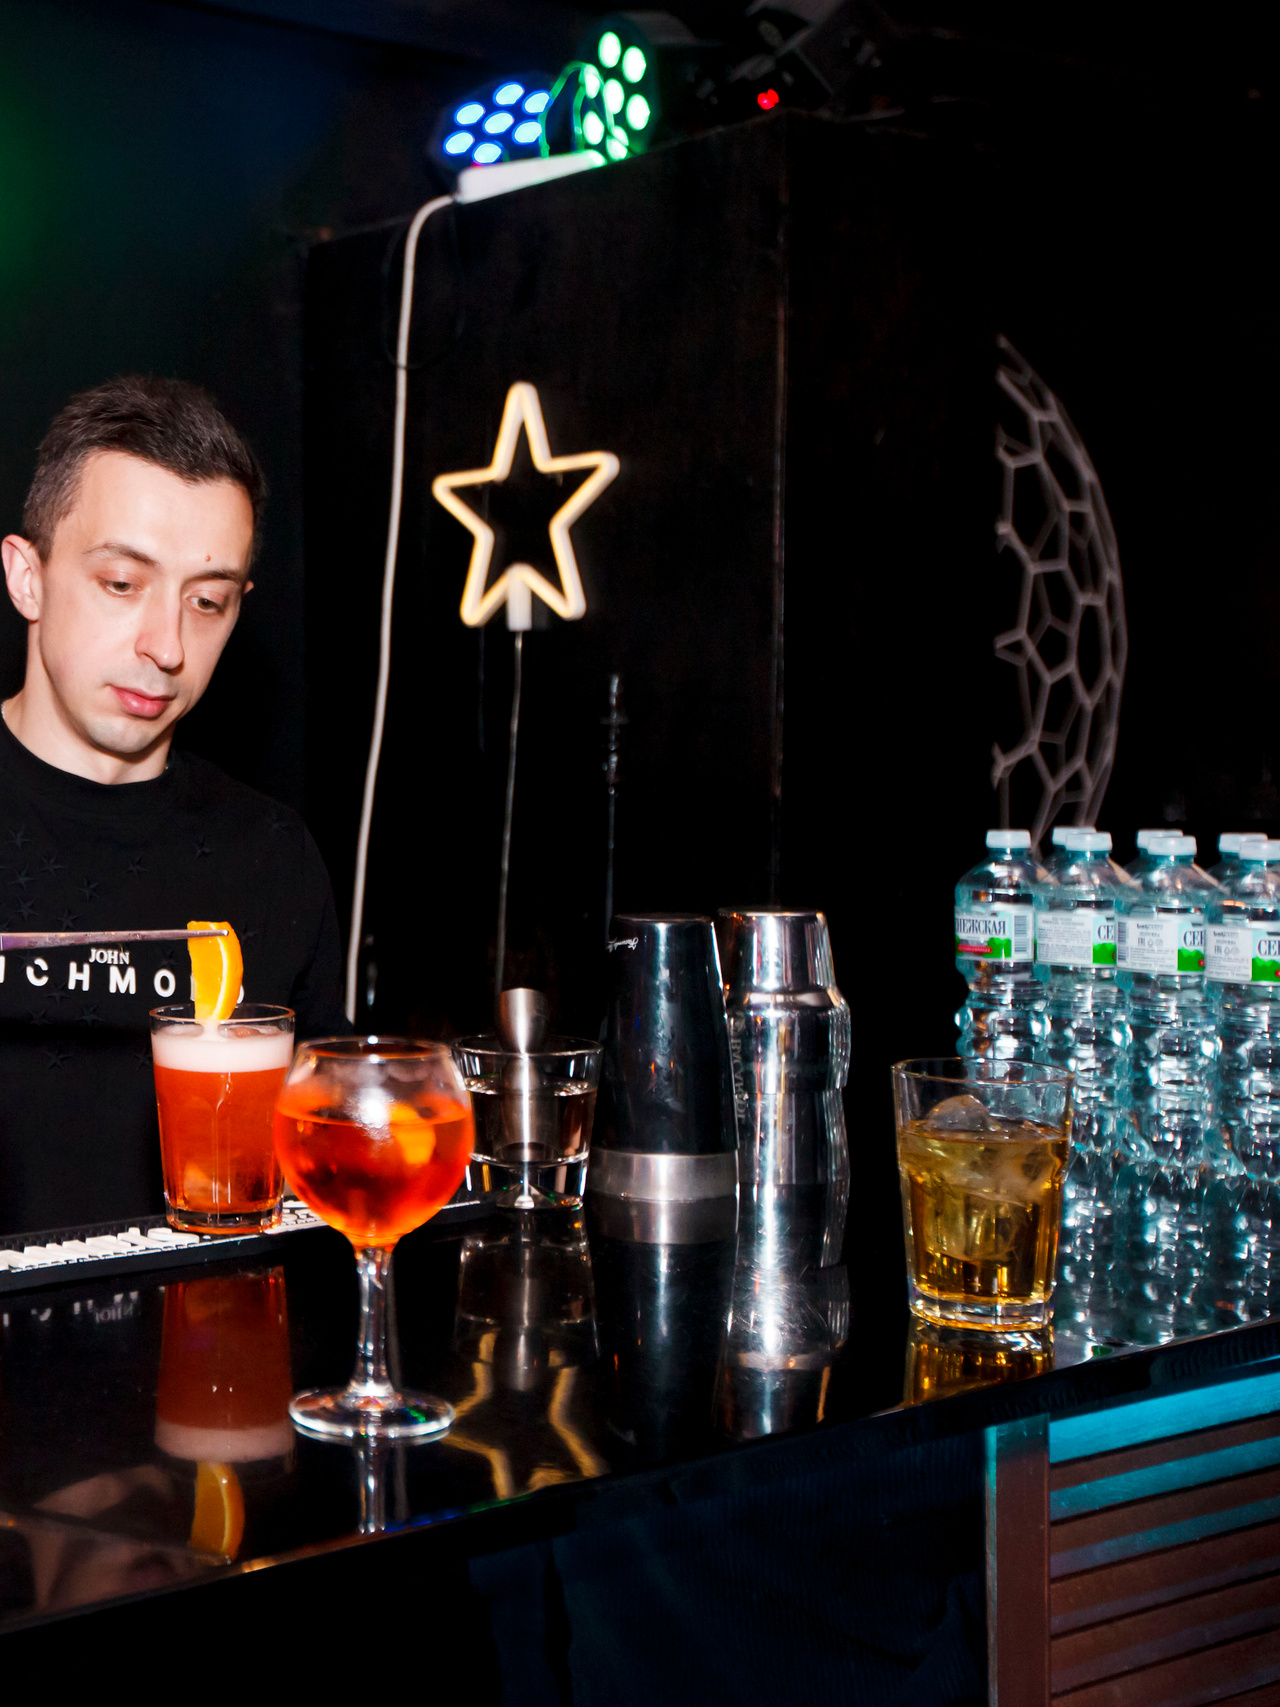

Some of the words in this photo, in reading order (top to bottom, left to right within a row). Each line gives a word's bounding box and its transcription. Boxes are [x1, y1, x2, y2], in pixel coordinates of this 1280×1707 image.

[955, 918, 1007, 936] НЕЖСКАЯ
[1097, 924, 1114, 941] СЕ
[89, 948, 130, 965] JOHN
